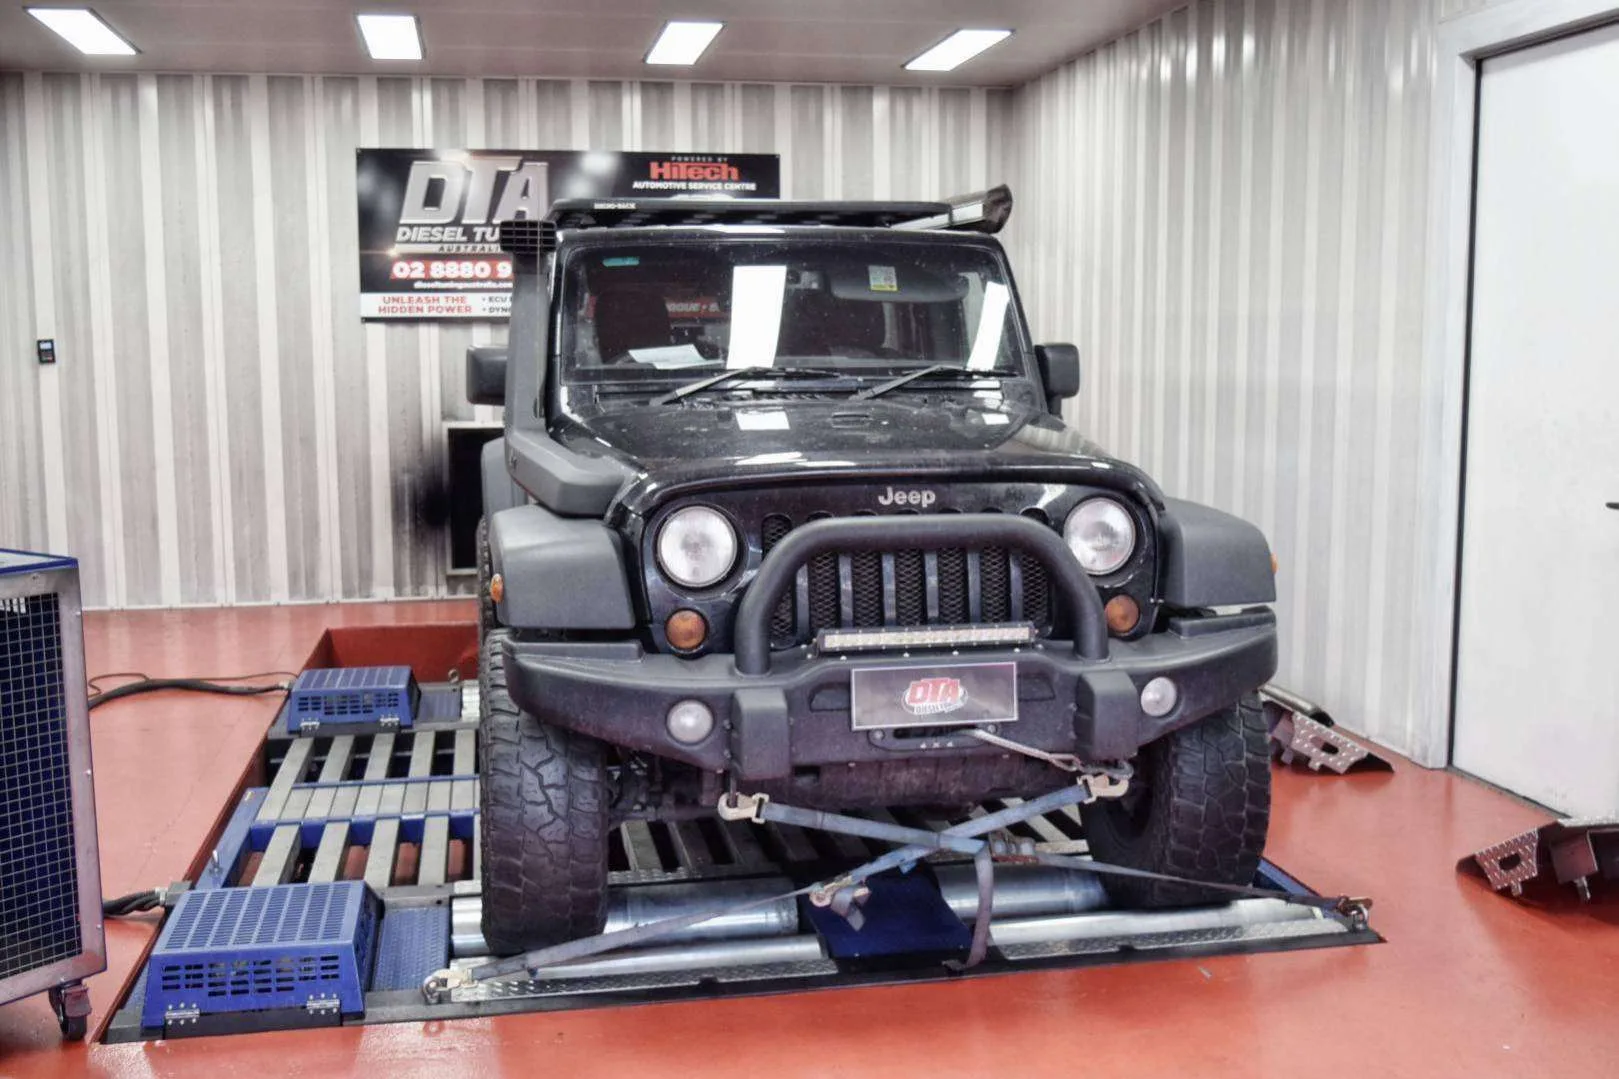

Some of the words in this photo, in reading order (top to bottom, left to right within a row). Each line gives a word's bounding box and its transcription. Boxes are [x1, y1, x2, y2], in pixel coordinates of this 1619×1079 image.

[649, 161, 739, 181] HiTech
[398, 156, 549, 224] DTA
[633, 181, 687, 190] AUTOMOTIVE
[688, 182, 723, 190] SERVICE
[724, 182, 756, 191] CENTRE
[395, 226, 468, 242] DIESEL
[472, 226, 500, 242] TU
[438, 244, 501, 253] AUSTRALI
[392, 261, 425, 279] 02
[430, 261, 492, 279] 8880
[496, 261, 513, 279] 9
[382, 296, 440, 304] UNLEASH
[444, 296, 467, 304] THE
[378, 305, 424, 313] HIDDEN
[427, 305, 472, 313] POWER
[877, 485, 936, 508] Jeep
[908, 677, 961, 704] DTA
